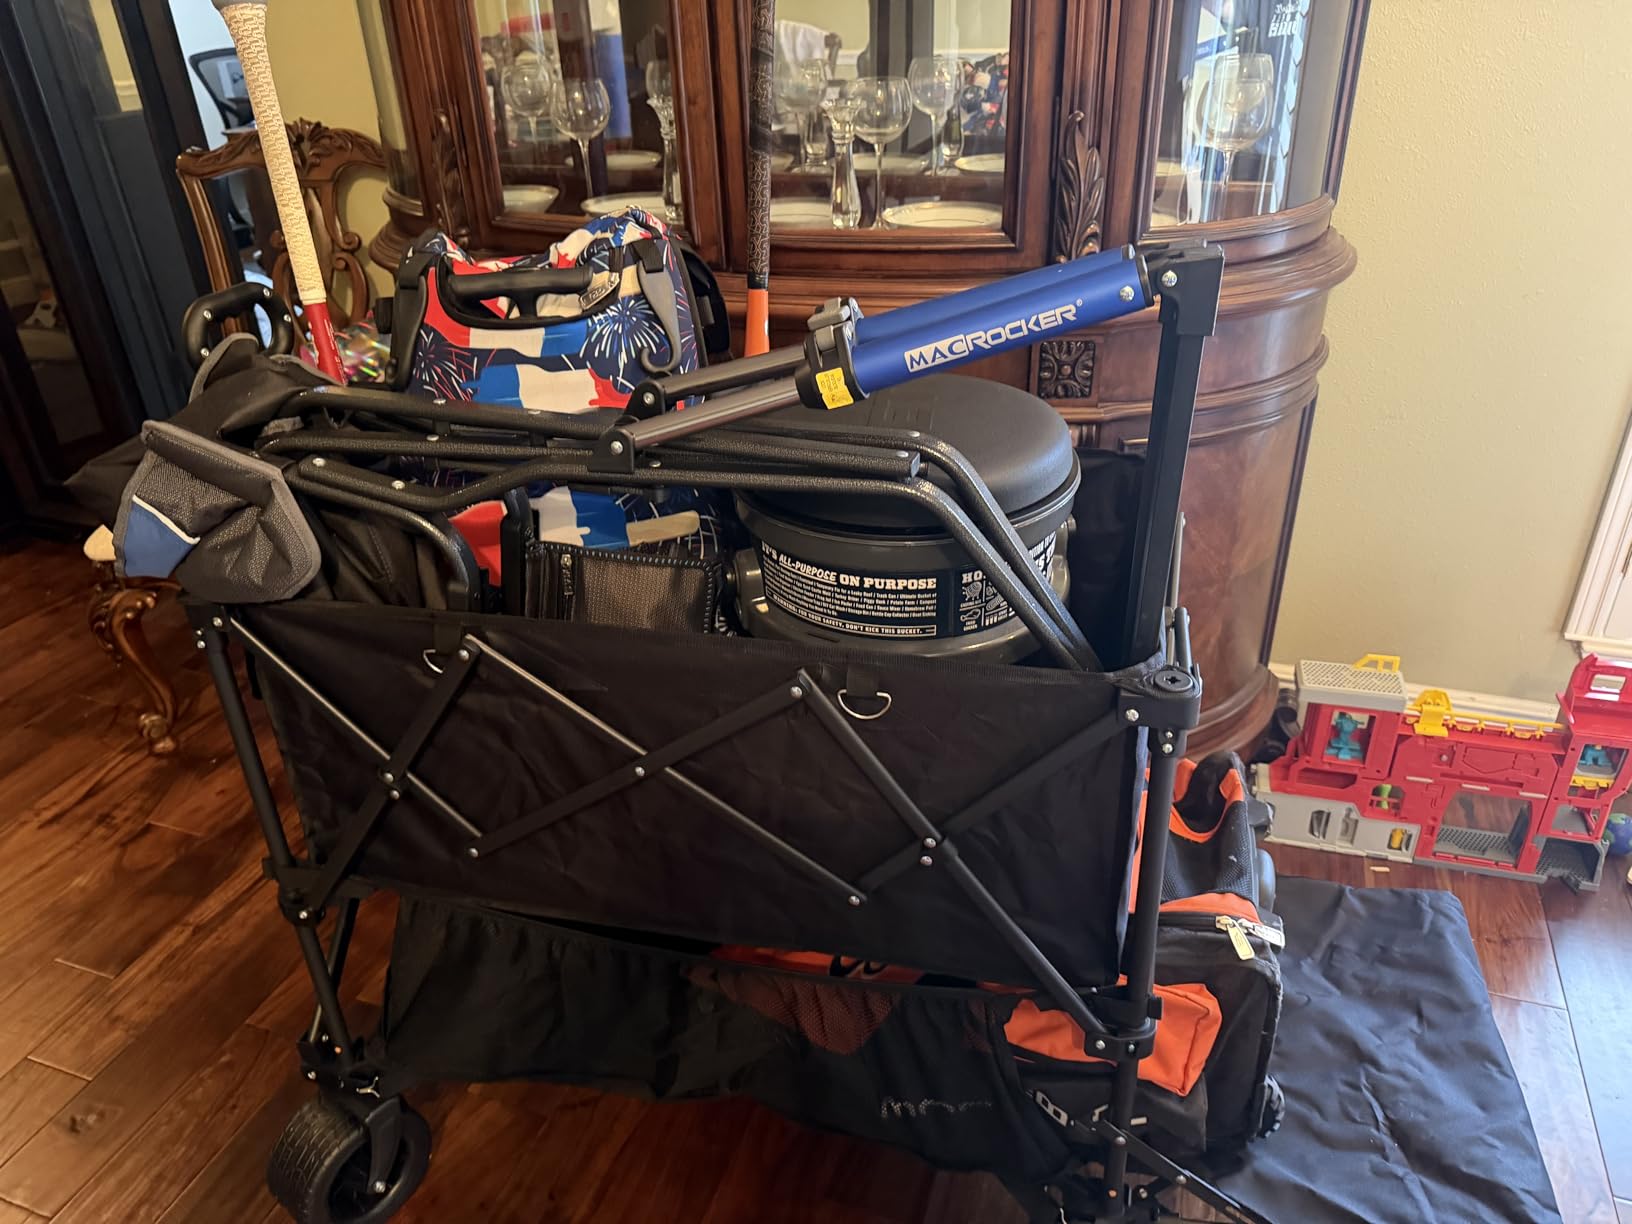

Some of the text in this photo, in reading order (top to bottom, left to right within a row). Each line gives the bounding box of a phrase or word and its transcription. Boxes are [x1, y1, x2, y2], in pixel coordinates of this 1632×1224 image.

[762, 541, 777, 559] IT'S
[779, 554, 837, 582] ALL-PURPOSE
[840, 574, 860, 587] ON
[864, 578, 937, 590] PURPOSE
[845, 623, 864, 631] DON'T
